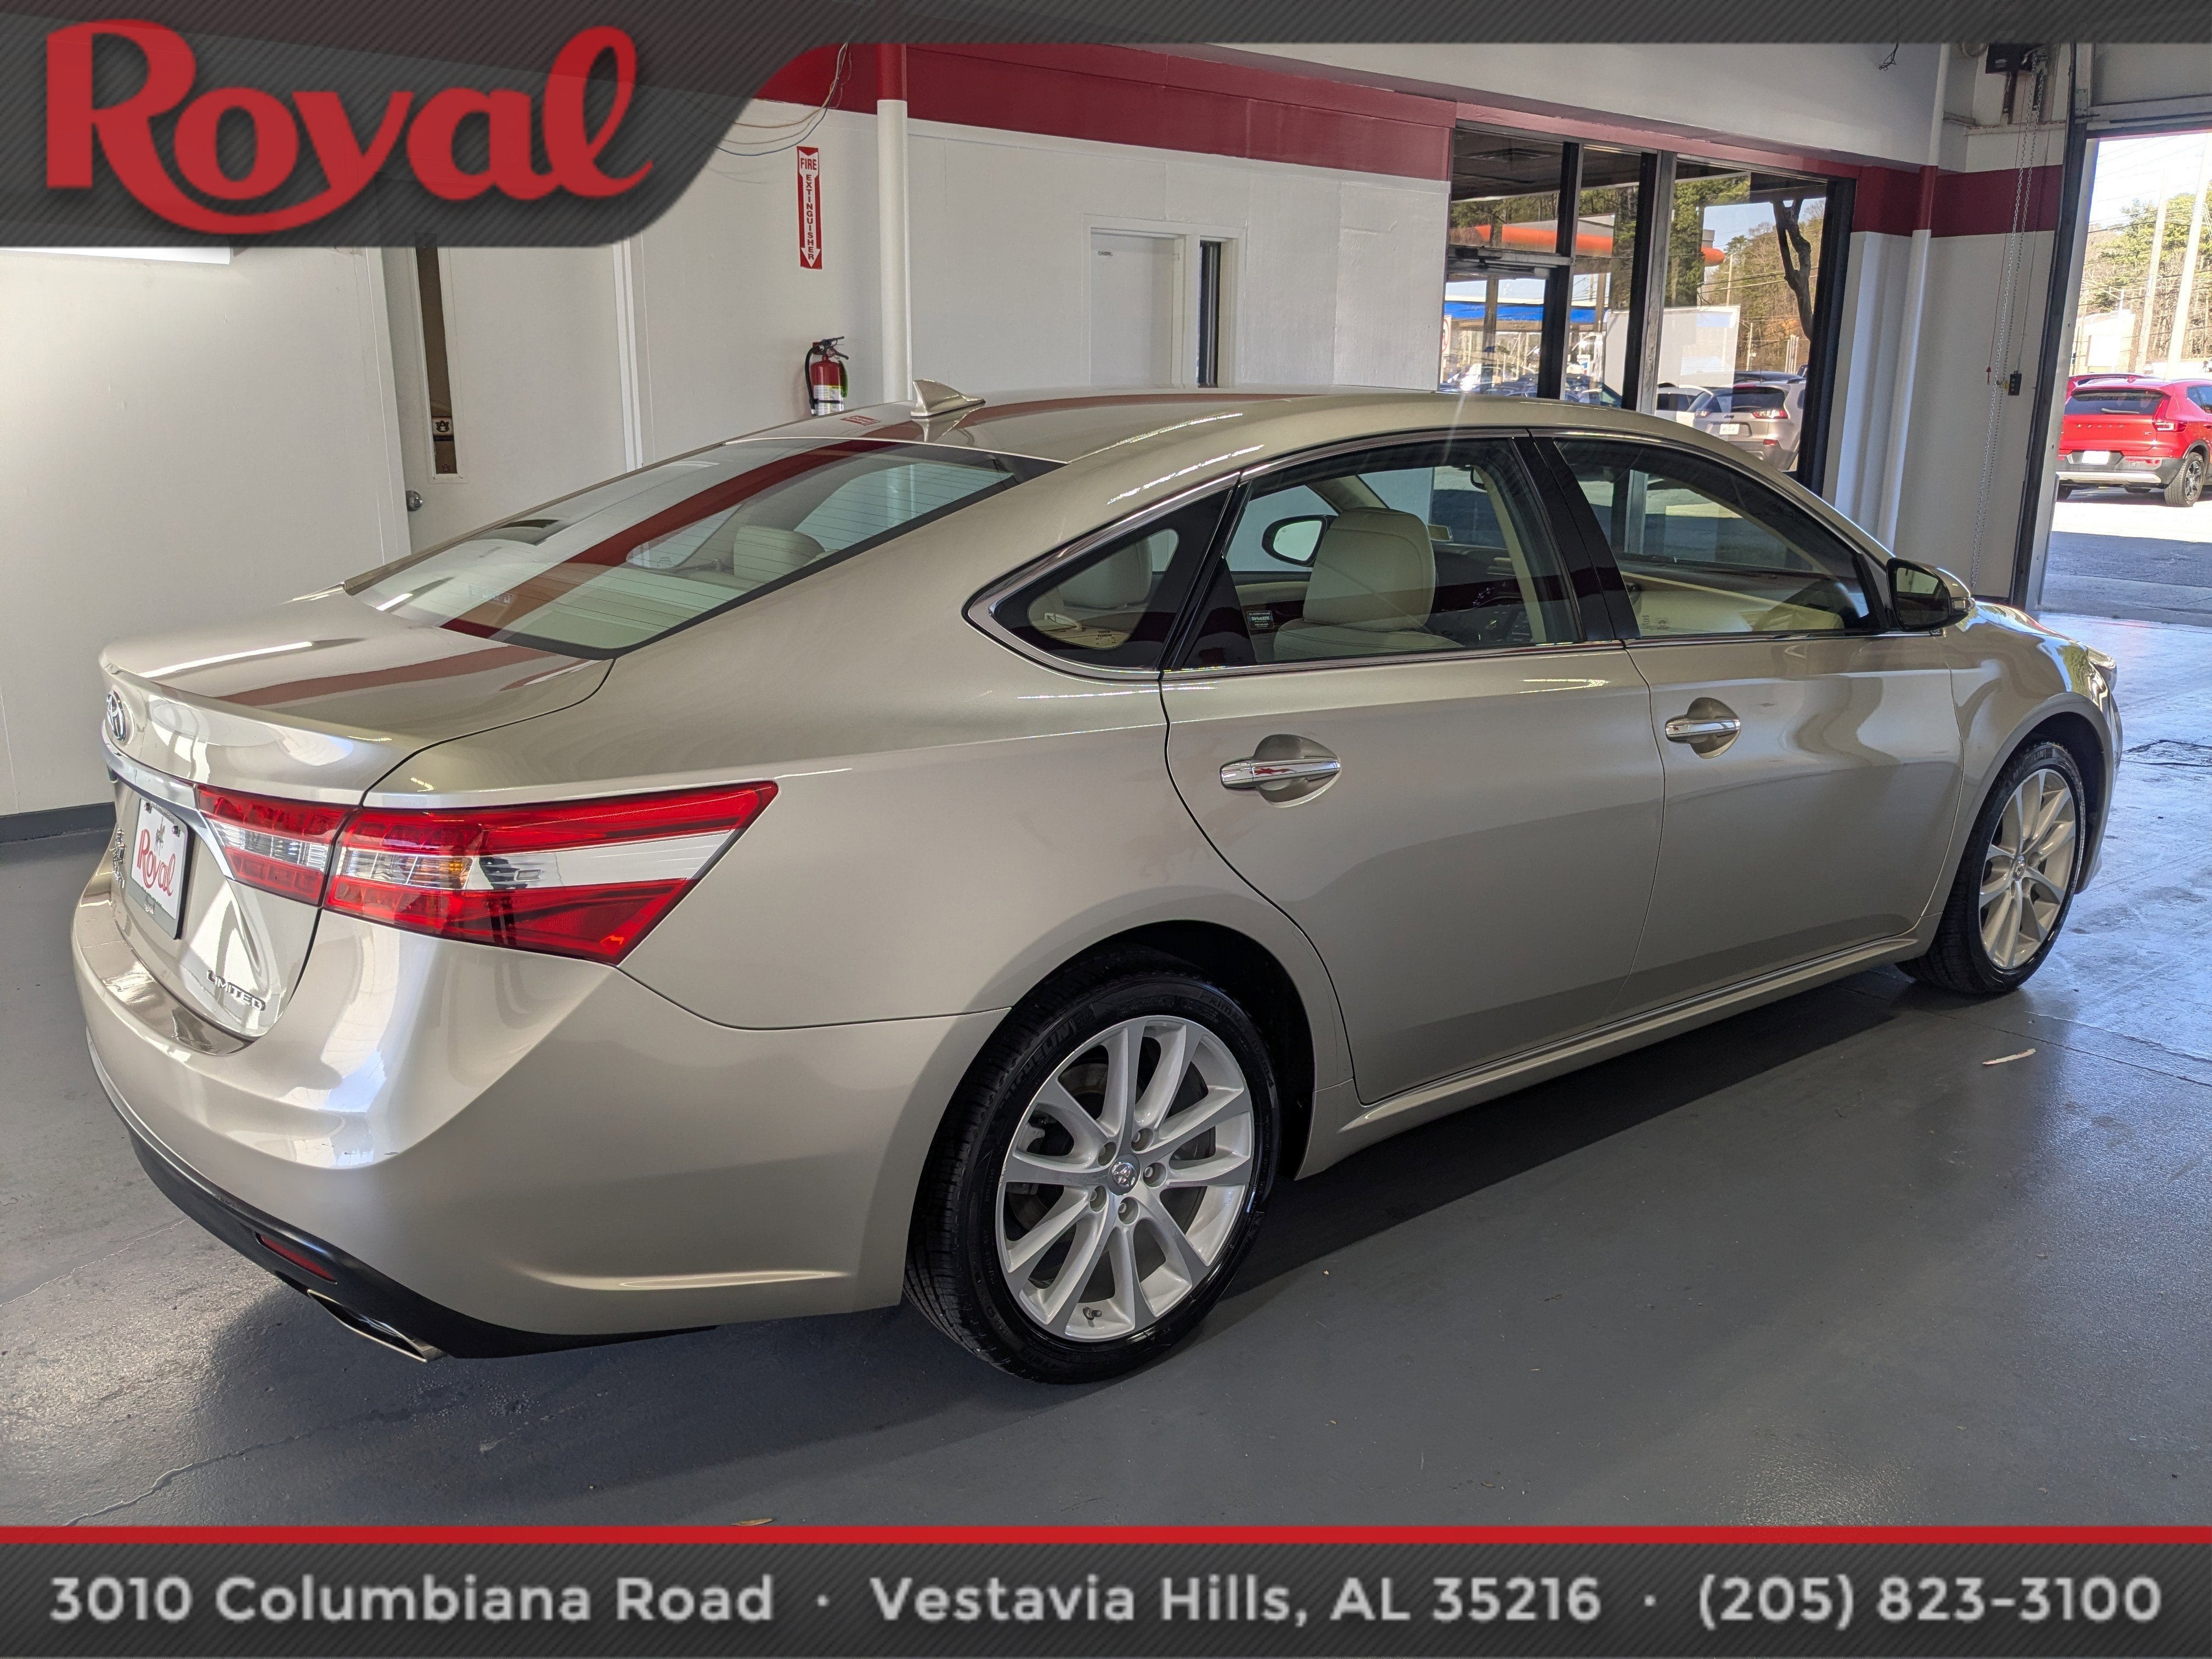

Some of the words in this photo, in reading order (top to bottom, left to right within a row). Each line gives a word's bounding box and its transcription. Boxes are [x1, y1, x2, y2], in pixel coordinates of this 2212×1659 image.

[800, 158, 817, 170] FIRE
[806, 174, 814, 260] EXTINGUISHER
[137, 828, 176, 896] Royal
[206, 970, 266, 1011] LIMITED
